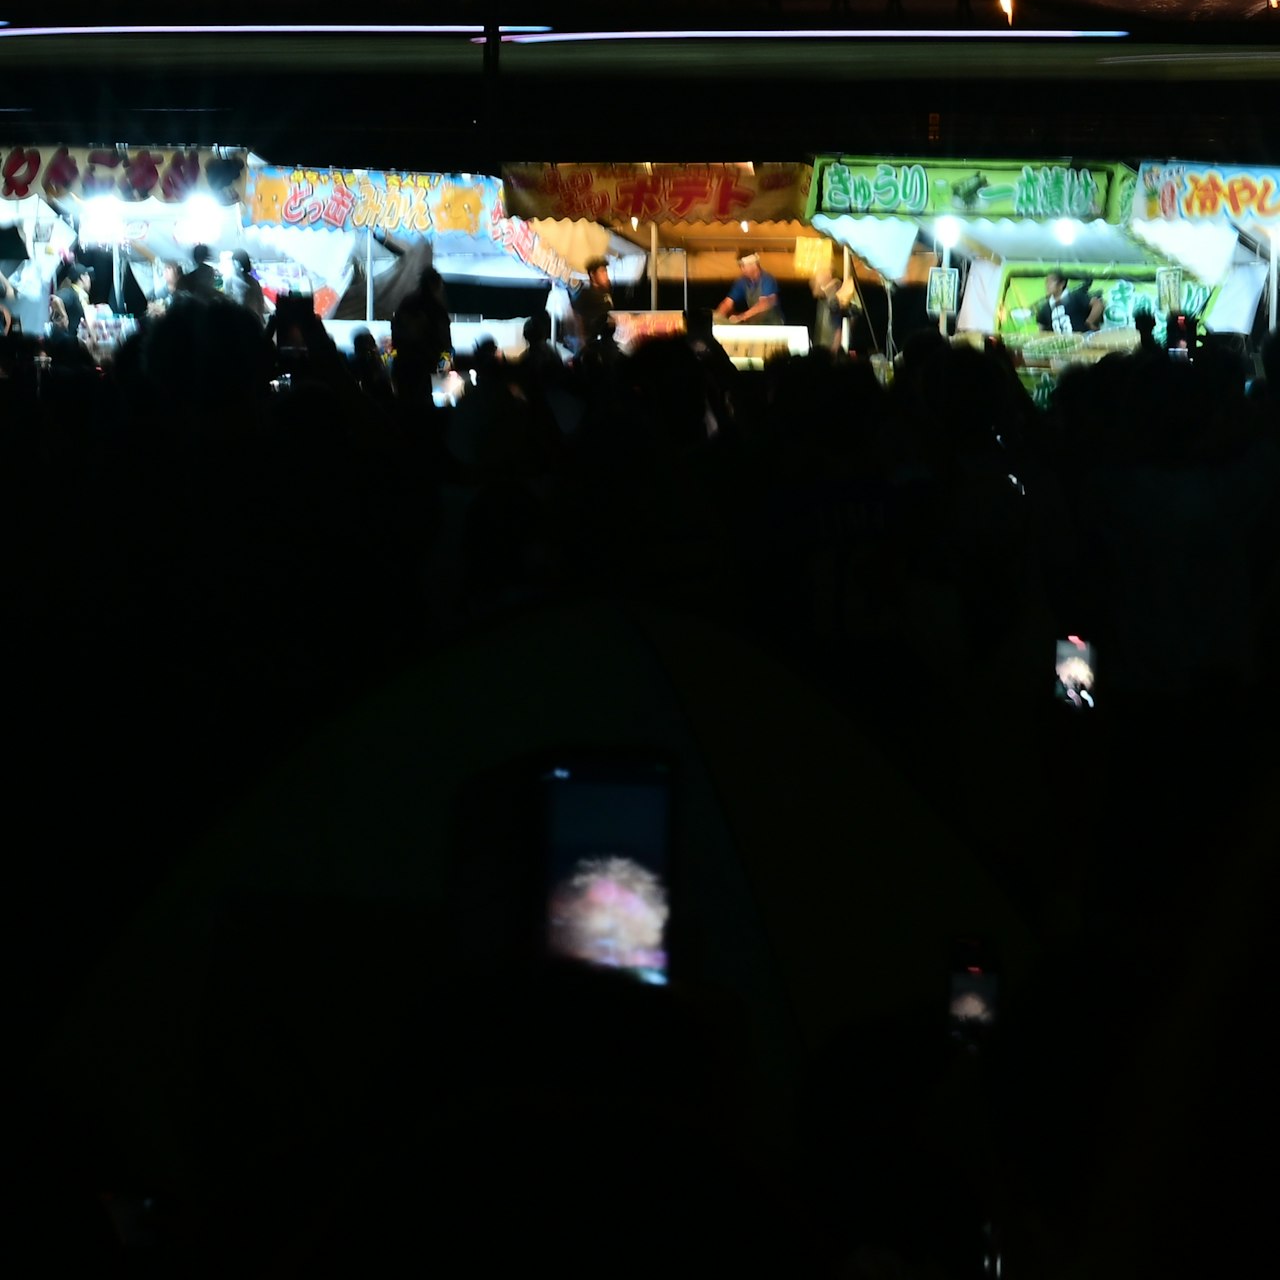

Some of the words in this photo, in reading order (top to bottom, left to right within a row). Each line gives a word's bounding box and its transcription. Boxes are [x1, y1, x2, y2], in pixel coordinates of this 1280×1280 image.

[617, 175, 755, 219] ポテト
[829, 163, 928, 212] きゅうり
